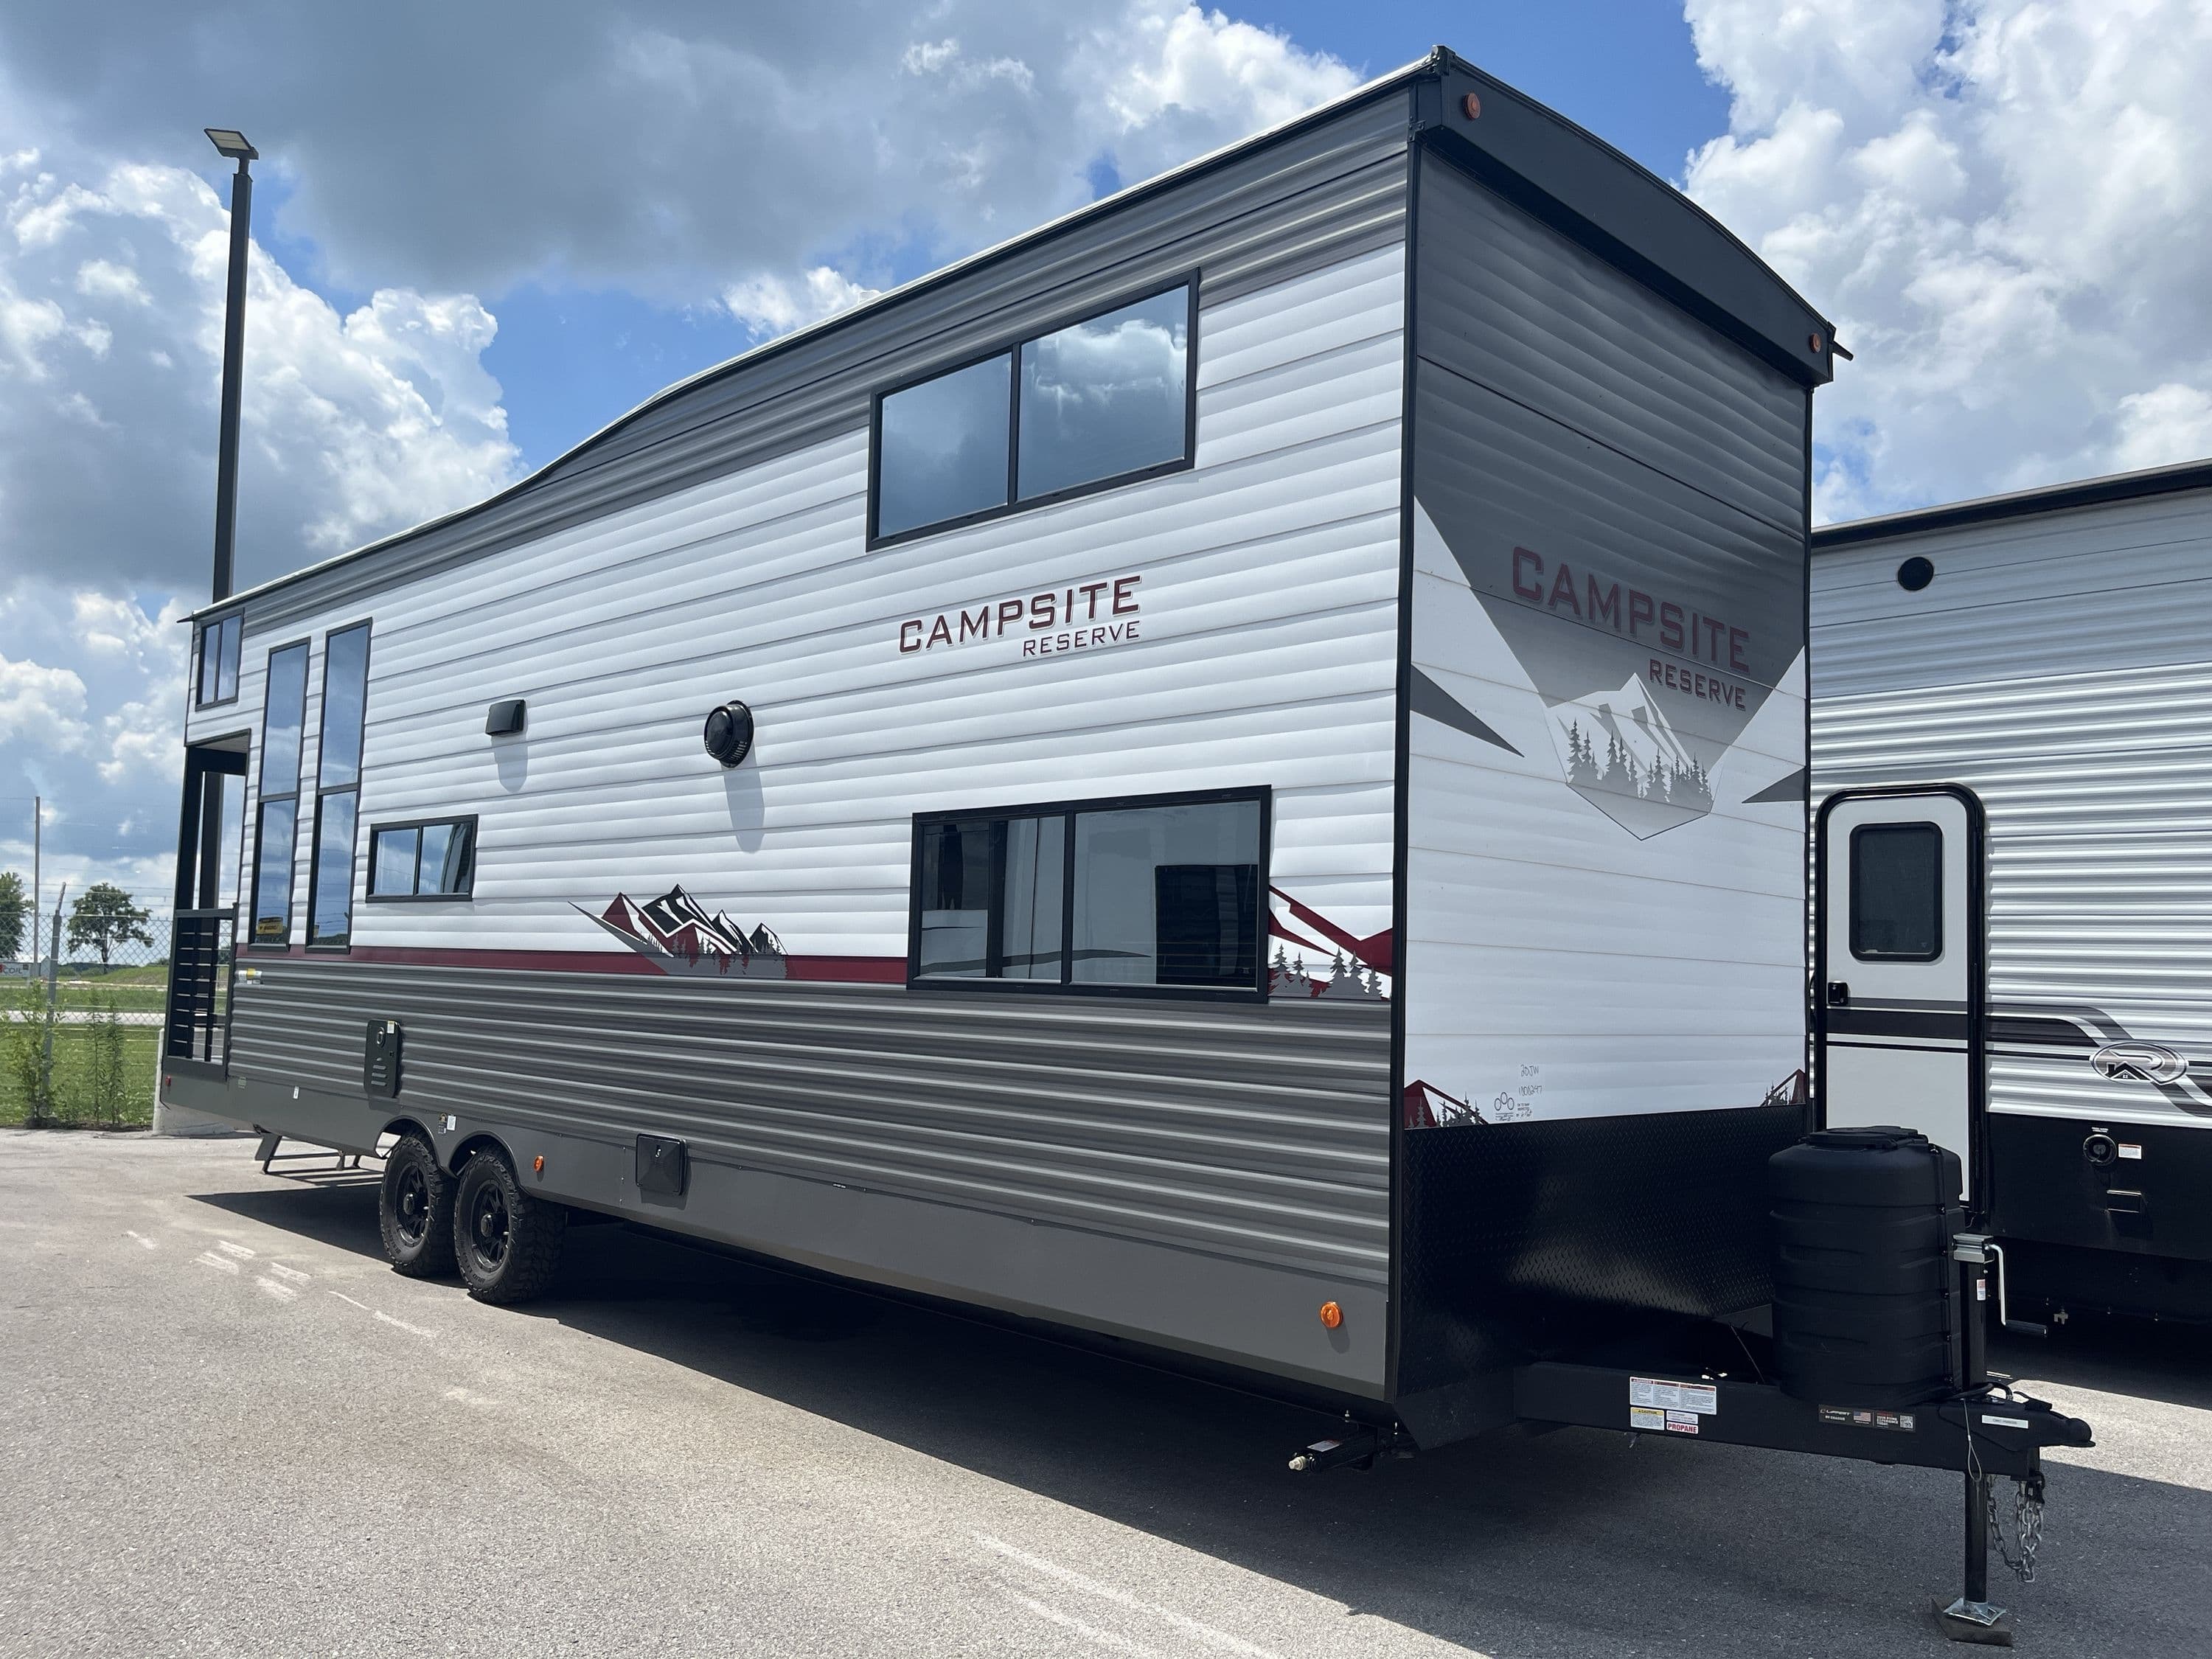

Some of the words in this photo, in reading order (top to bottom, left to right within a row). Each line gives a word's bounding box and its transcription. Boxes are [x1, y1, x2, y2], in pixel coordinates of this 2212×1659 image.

[899, 575, 1141, 653] CAMPSITE
[1512, 546, 1750, 673] CAMPSITE
[1023, 620, 1140, 657] RESERVE
[1649, 658, 1747, 711] RESERVE
[1668, 1423, 1697, 1433] PROPANE
